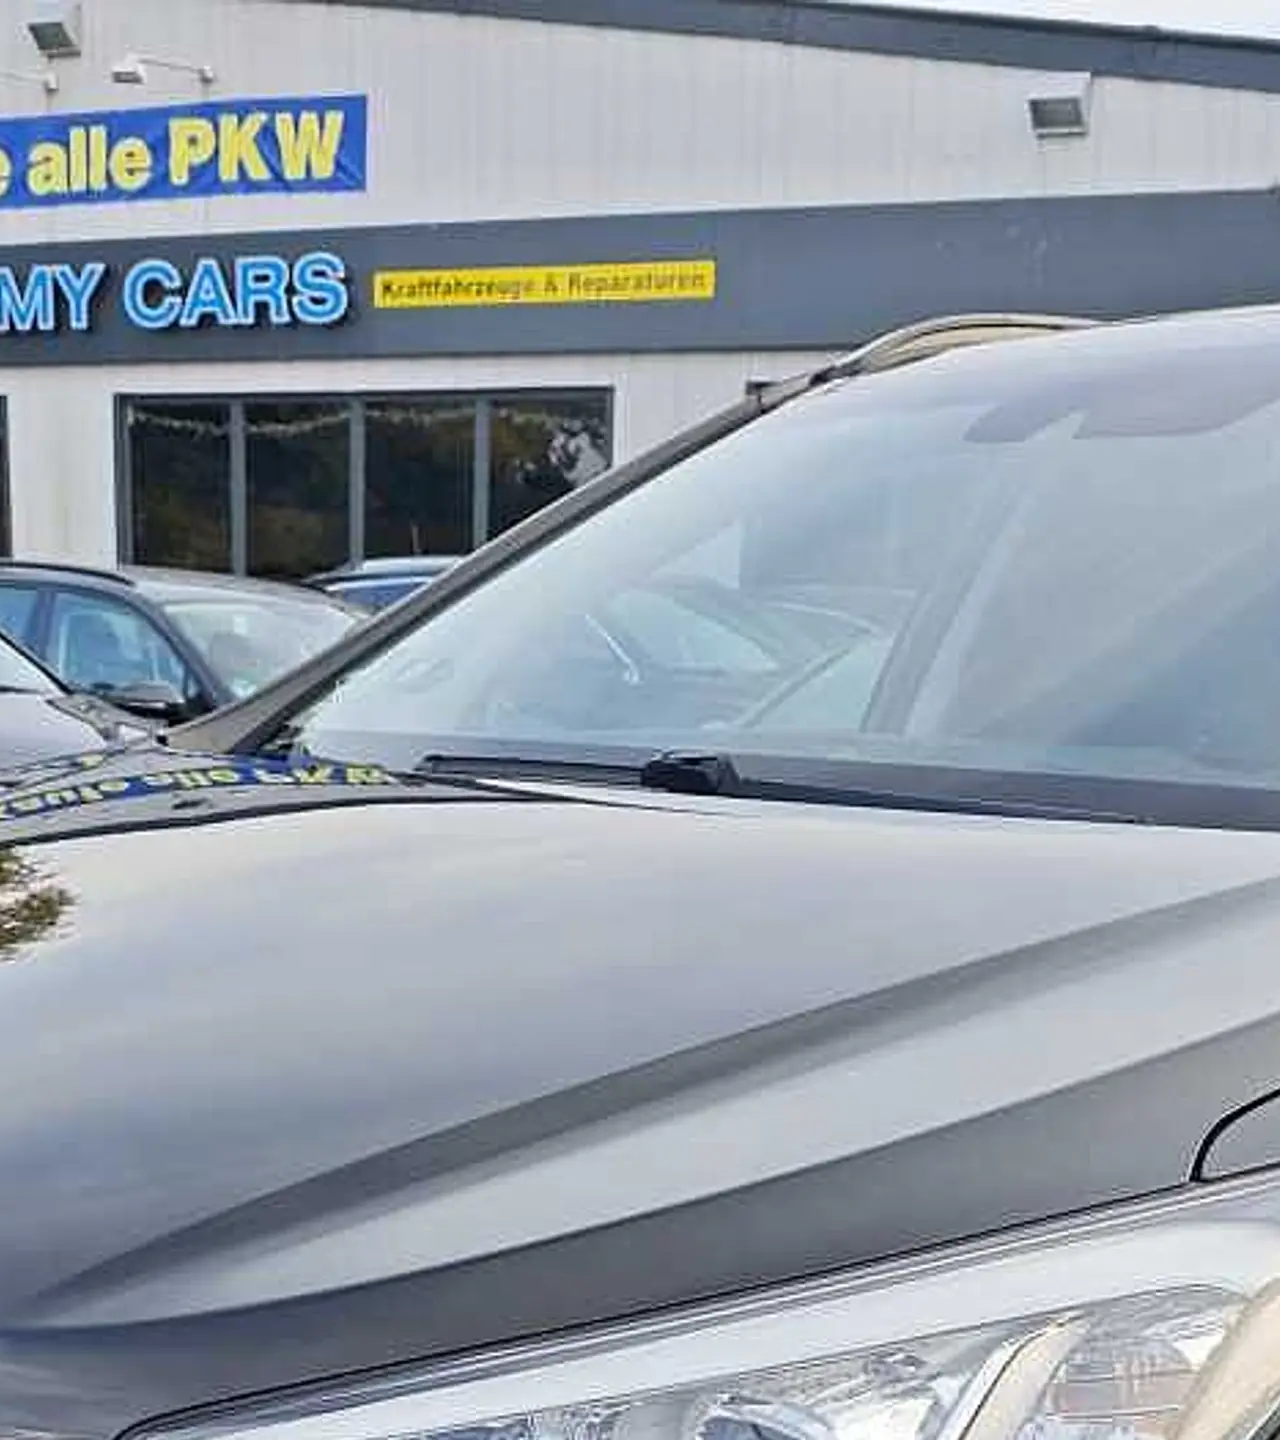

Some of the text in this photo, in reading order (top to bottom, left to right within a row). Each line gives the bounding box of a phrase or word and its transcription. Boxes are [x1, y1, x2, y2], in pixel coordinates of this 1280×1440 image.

[26, 124, 154, 198] alle
[167, 109, 345, 188] PKW
[123, 251, 350, 330] CARS
